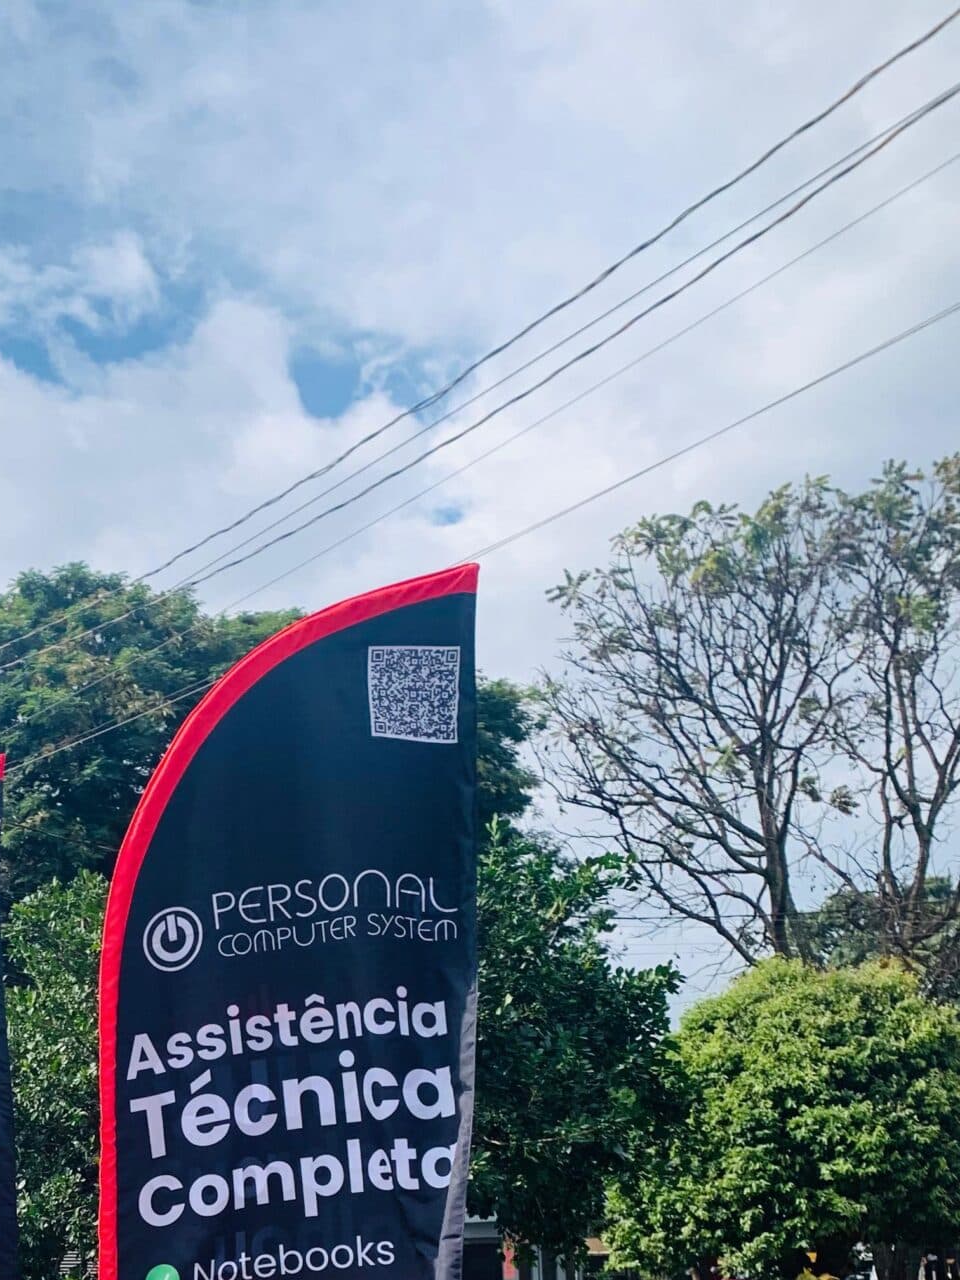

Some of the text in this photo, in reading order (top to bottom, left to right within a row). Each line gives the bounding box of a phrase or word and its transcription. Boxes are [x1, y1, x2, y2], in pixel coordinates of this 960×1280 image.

[212, 869, 459, 930] PERSONAL
[217, 912, 458, 957] COMPUTER SYSTEM
[126, 985, 448, 1081] Assistência
[130, 1049, 457, 1160] Técnica
